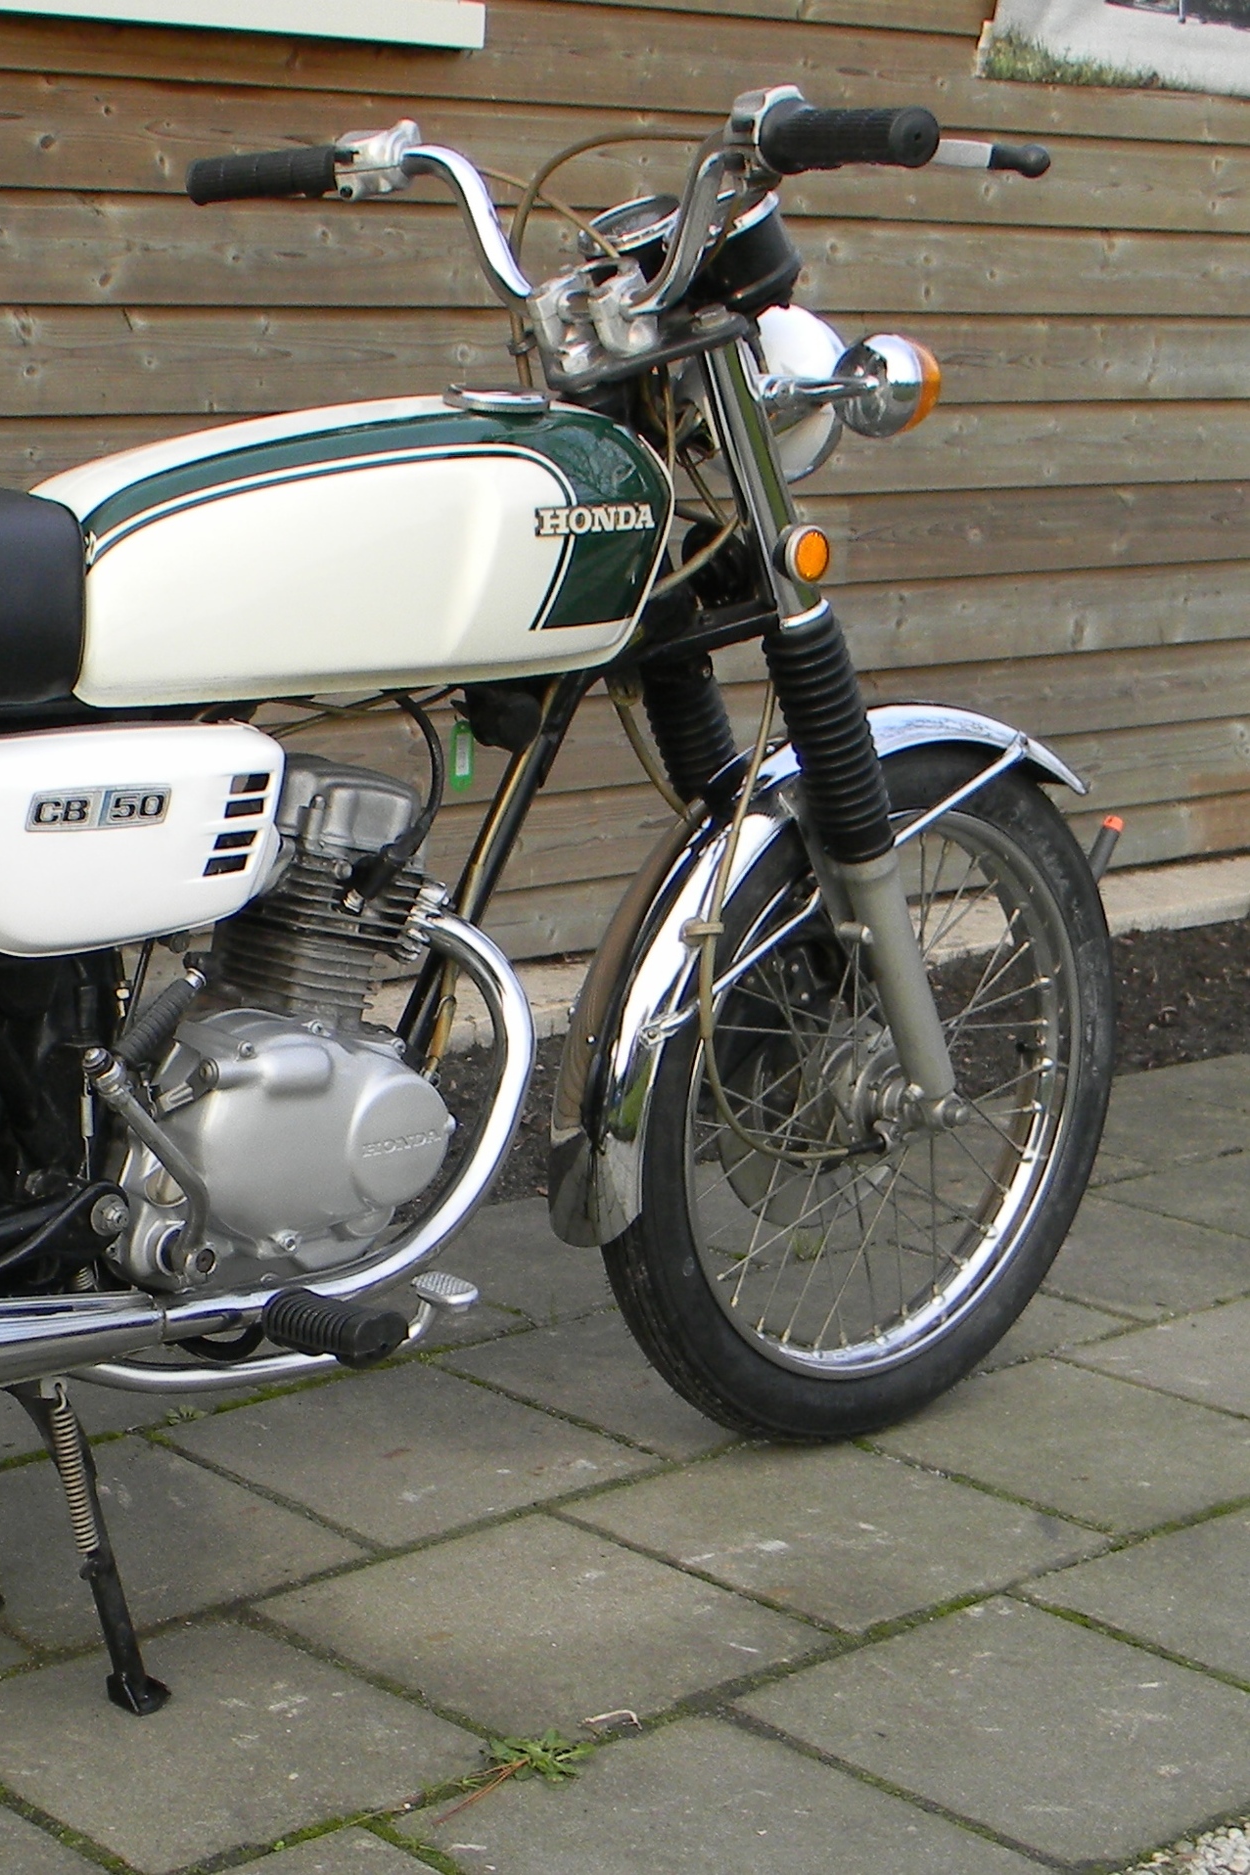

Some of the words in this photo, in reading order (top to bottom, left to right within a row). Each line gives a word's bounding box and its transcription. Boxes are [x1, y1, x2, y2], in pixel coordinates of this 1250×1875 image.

[538, 502, 656, 535] HONDA
[34, 799, 89, 824] CB
[111, 793, 166, 819] 50
[362, 1129, 442, 1158] HONDA
